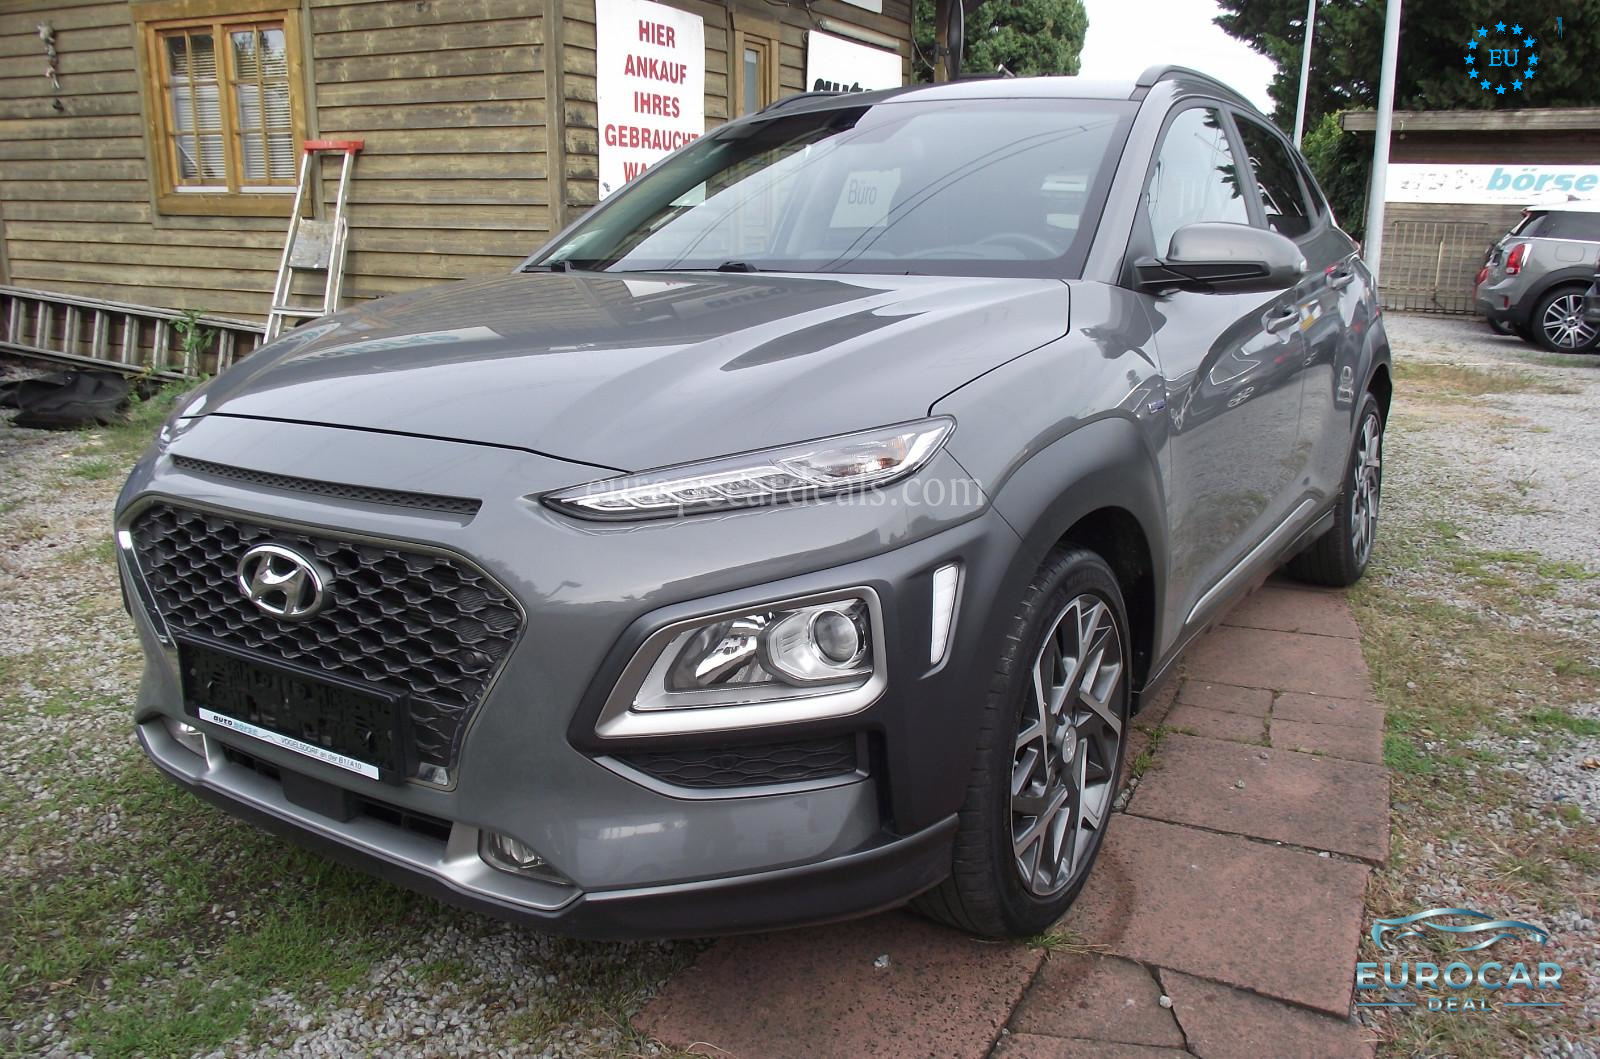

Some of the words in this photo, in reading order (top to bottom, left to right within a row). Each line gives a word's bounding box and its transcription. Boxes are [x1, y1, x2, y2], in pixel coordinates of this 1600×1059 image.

[638, 19, 676, 49] HIER
[624, 54, 687, 85] ANKAUF
[634, 91, 681, 118] IHRES
[847, 178, 878, 206] Büro
[1486, 167, 1599, 192] börse
[213, 715, 233, 726] auto
